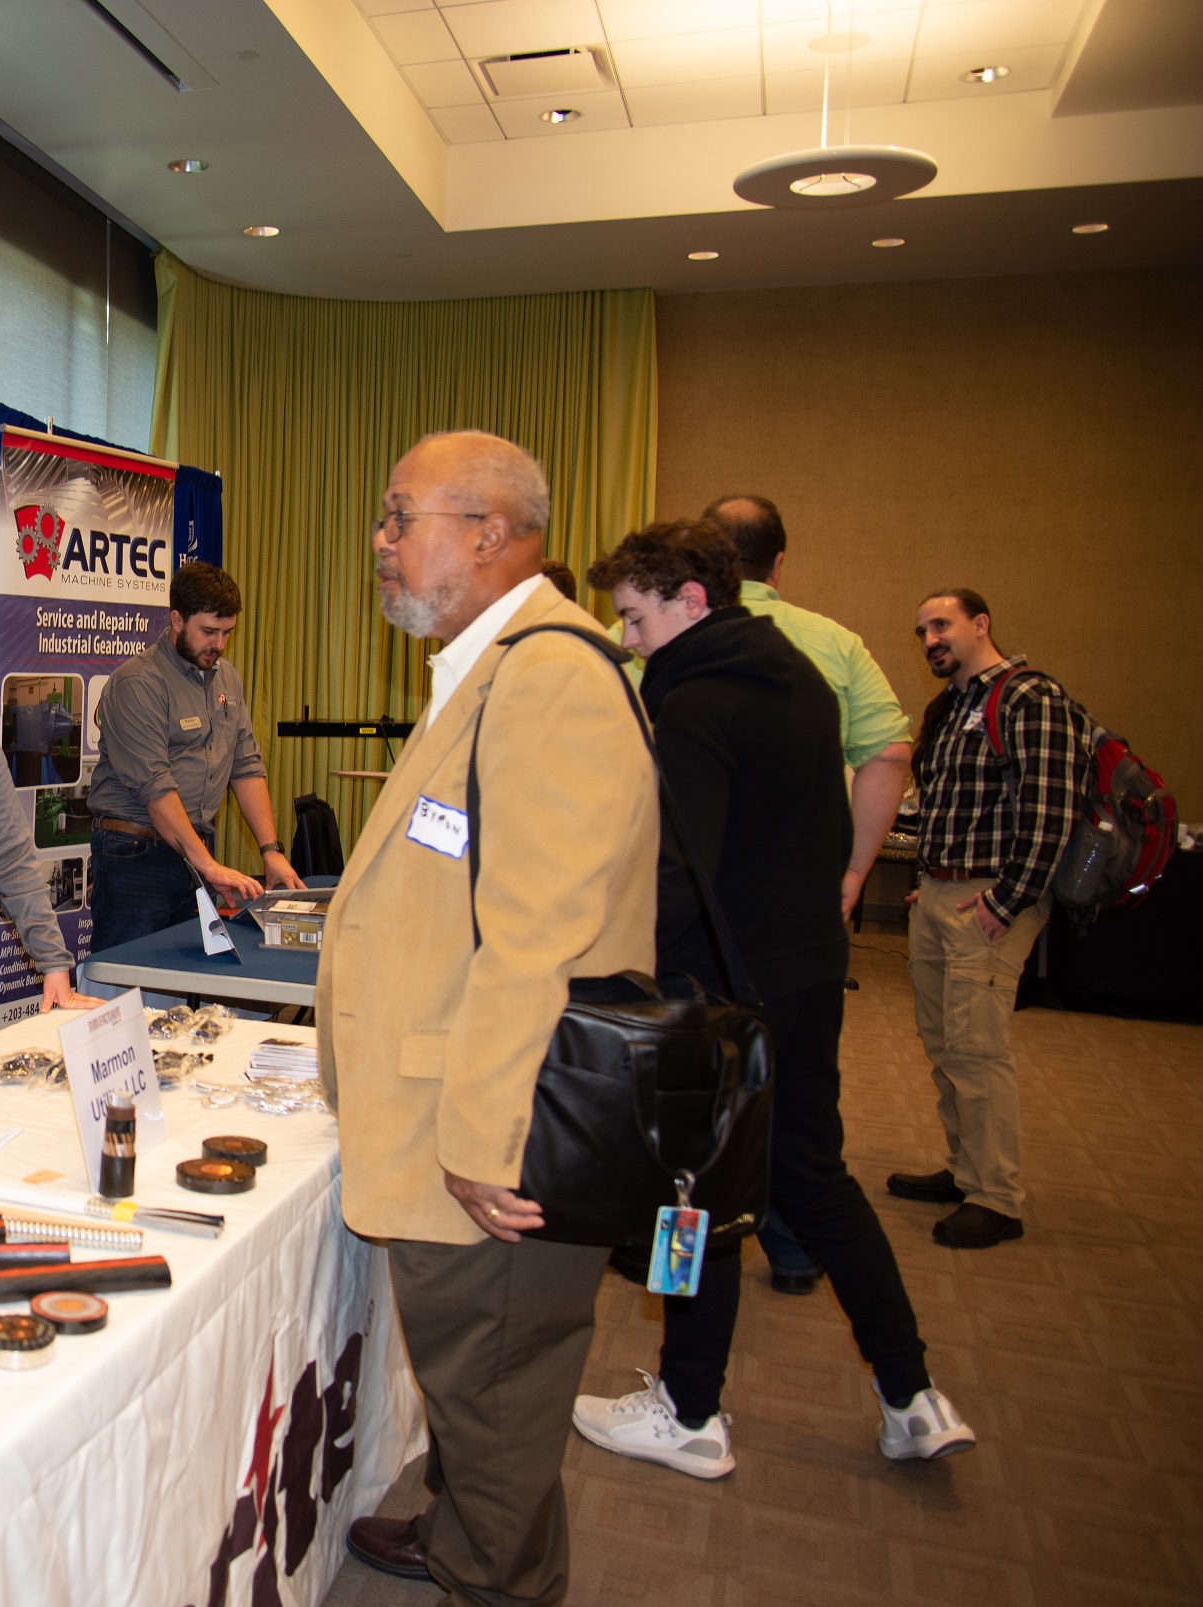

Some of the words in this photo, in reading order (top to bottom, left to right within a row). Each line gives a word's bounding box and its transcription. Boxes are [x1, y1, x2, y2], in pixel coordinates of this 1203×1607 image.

[62, 528, 166, 580] ARTEC
[61, 573, 112, 588] MACHINE
[117, 579, 166, 592] SYSTEMS
[36, 606, 74, 629] Service
[76, 612, 98, 630] and
[99, 610, 134, 636] Repair
[134, 612, 150, 633] for
[38, 632, 92, 655] Industrial
[93, 634, 146, 656] Gearboxes
[2, 1002, 40, 1023] +203-484
[90, 1046, 136, 1085] Marmon
